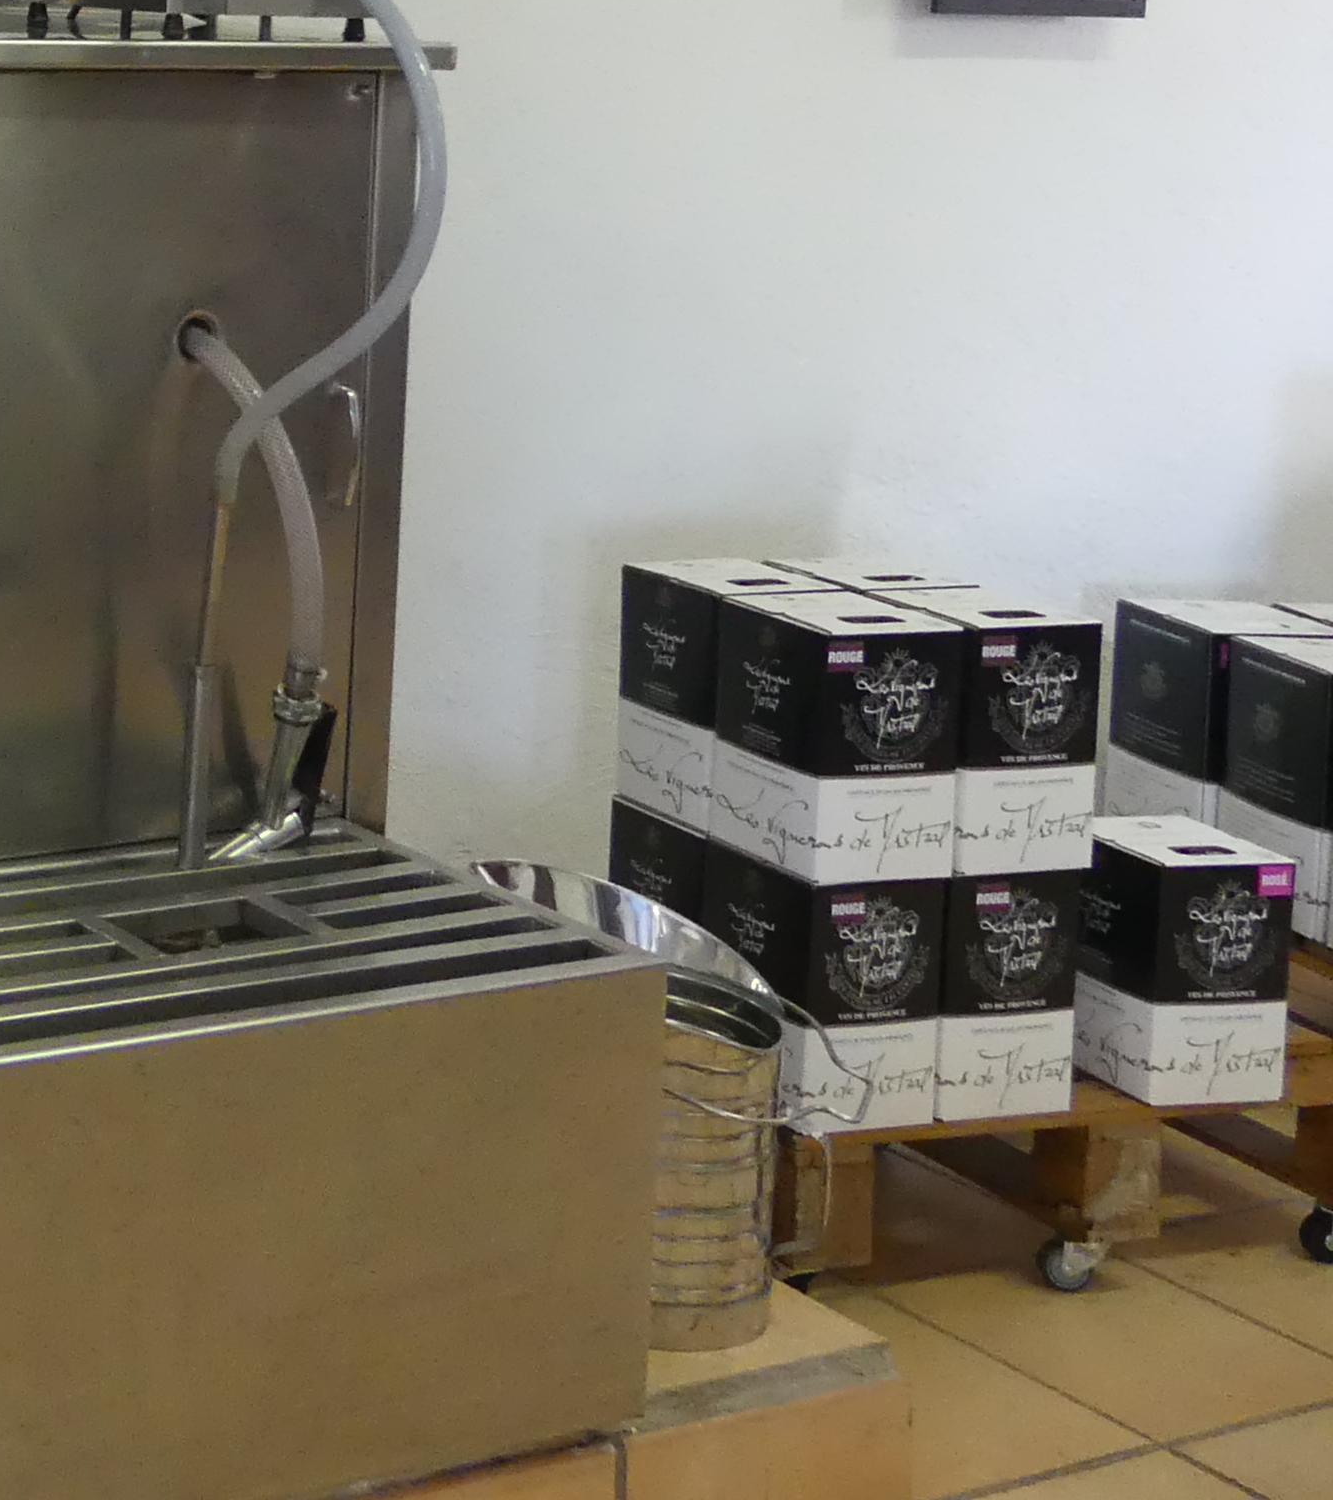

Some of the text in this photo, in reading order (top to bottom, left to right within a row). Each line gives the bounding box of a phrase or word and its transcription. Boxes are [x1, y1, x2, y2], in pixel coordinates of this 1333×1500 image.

[827, 650, 864, 664] ROUGE
[982, 644, 1017, 659] ROUGE
[976, 891, 1010, 905] ROUGE
[831, 902, 866, 916] ROUGE
